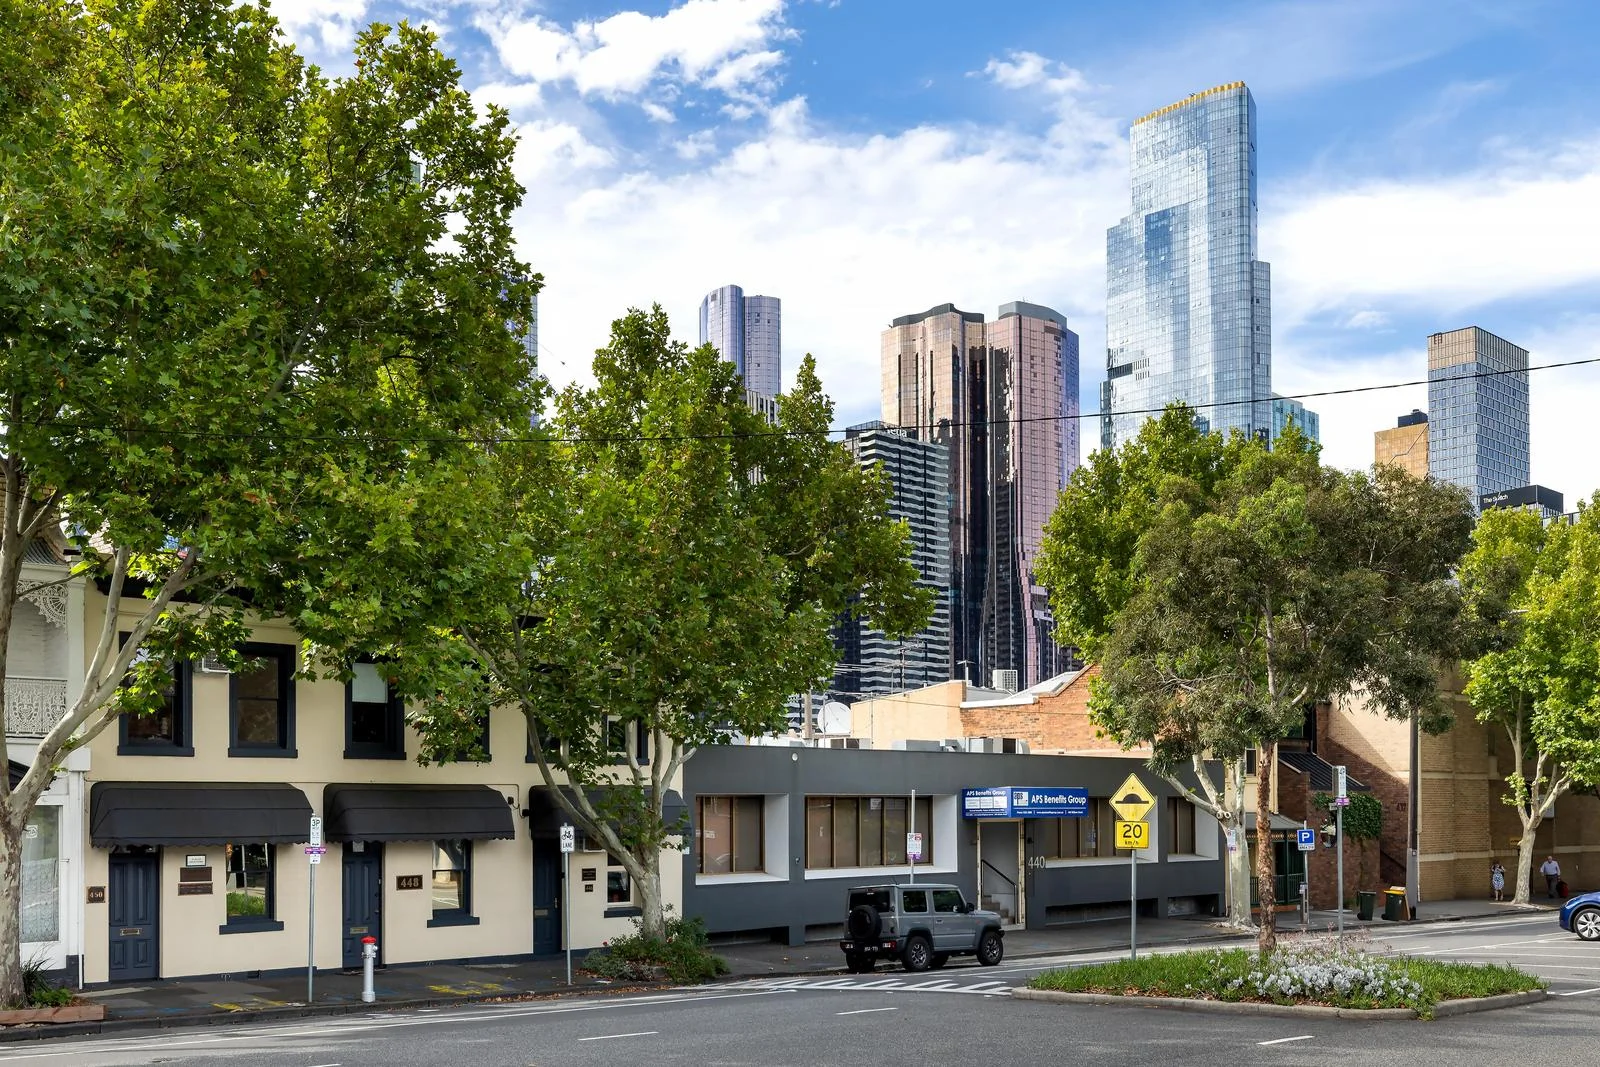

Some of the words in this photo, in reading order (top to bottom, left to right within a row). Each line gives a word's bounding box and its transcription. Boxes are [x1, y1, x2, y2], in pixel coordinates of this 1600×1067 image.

[1031, 795, 1043, 804] APS
[1044, 795, 1067, 804] Benefits
[1067, 795, 1087, 805] Group
[311, 819, 321, 827] 3P
[1123, 824, 1142, 838] 20
[1301, 832, 1310, 842] P
[1028, 855, 1045, 869] 440
[400, 877, 419, 888] 448
